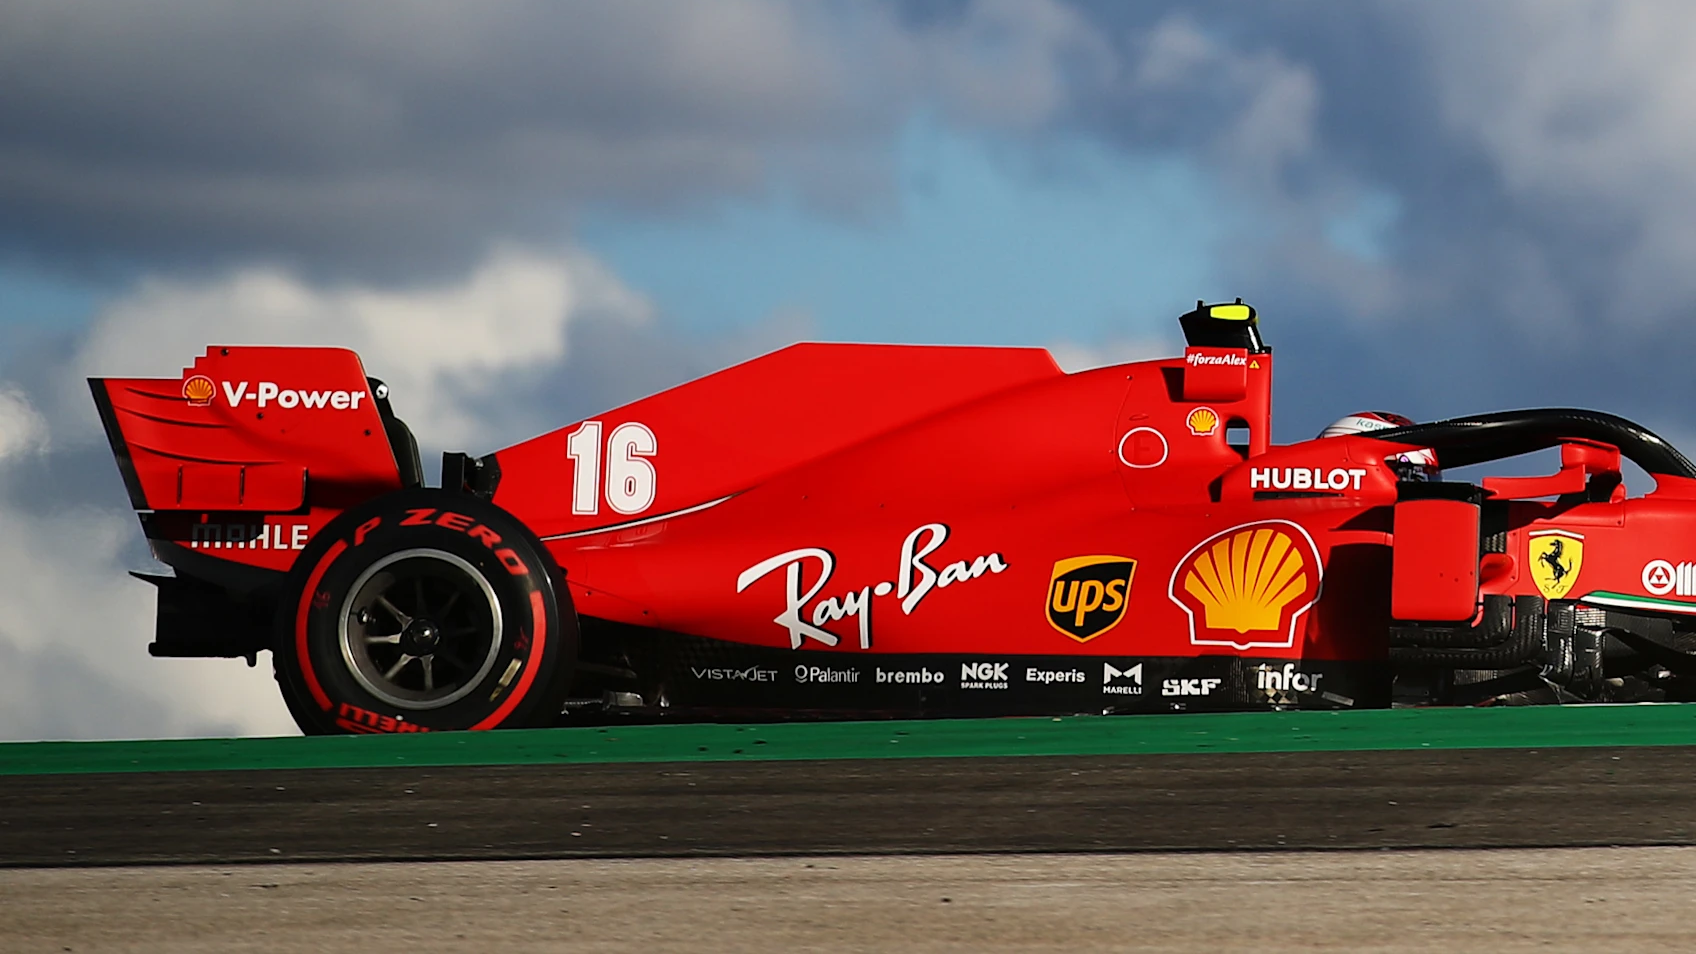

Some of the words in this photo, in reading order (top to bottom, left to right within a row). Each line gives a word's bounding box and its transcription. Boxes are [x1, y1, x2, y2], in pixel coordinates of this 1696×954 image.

[1186, 352, 1247, 367] #forzaAlex
[221, 381, 366, 410] V-Power
[566, 420, 658, 516] 16
[1250, 467, 1367, 490] HUBLOT
[353, 515, 382, 547] P
[399, 507, 530, 577] ZERO
[1051, 578, 1126, 627] ups
[809, 666, 861, 683] Palantir
[875, 667, 945, 684] brembo
[960, 662, 1010, 681] NGK
[1025, 667, 1086, 684] Experis
[1257, 663, 1323, 692] infor
[985, 682, 1009, 690] PLUGS
[1103, 686, 1142, 695] MARELLI
[1161, 678, 1222, 696] SKF
